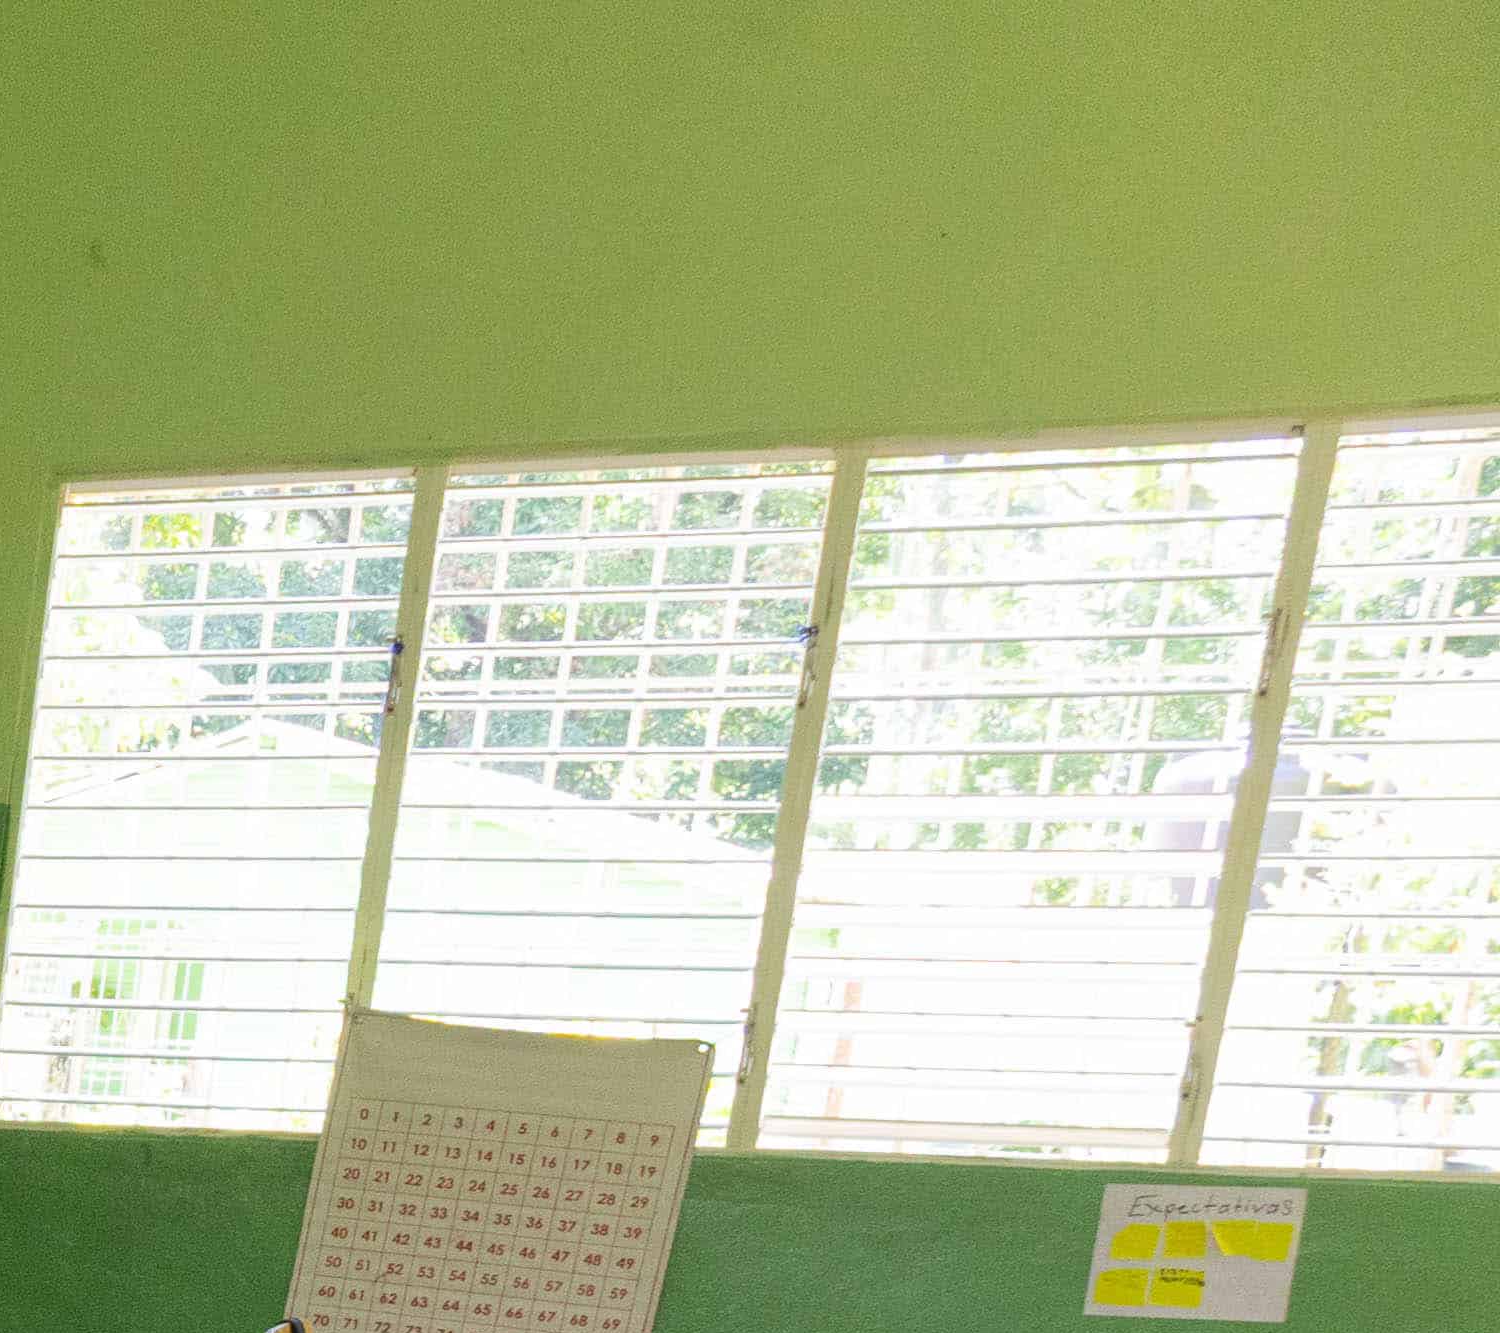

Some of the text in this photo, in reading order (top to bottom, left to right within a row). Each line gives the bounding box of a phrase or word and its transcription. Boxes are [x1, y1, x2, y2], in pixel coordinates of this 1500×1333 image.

[359, 1107, 660, 1147] 0 1 2 3 4 5 6 7 8 9
[351, 1137, 658, 1178] 10 11 12 13 14 15 16 17 18 19
[342, 1167, 650, 1209] 20 21 22 23 24 25 26 27 28 29
[1126, 1195, 1295, 1222] Expectativas
[336, 1196, 643, 1240] 30 31 32 33 34 35 36 37 38 39
[330, 1226, 636, 1270] 40 41 42 43 44 45 46 47 48 49
[324, 1255, 629, 1300] 50 51 52 53 54 55 56 57 58 59
